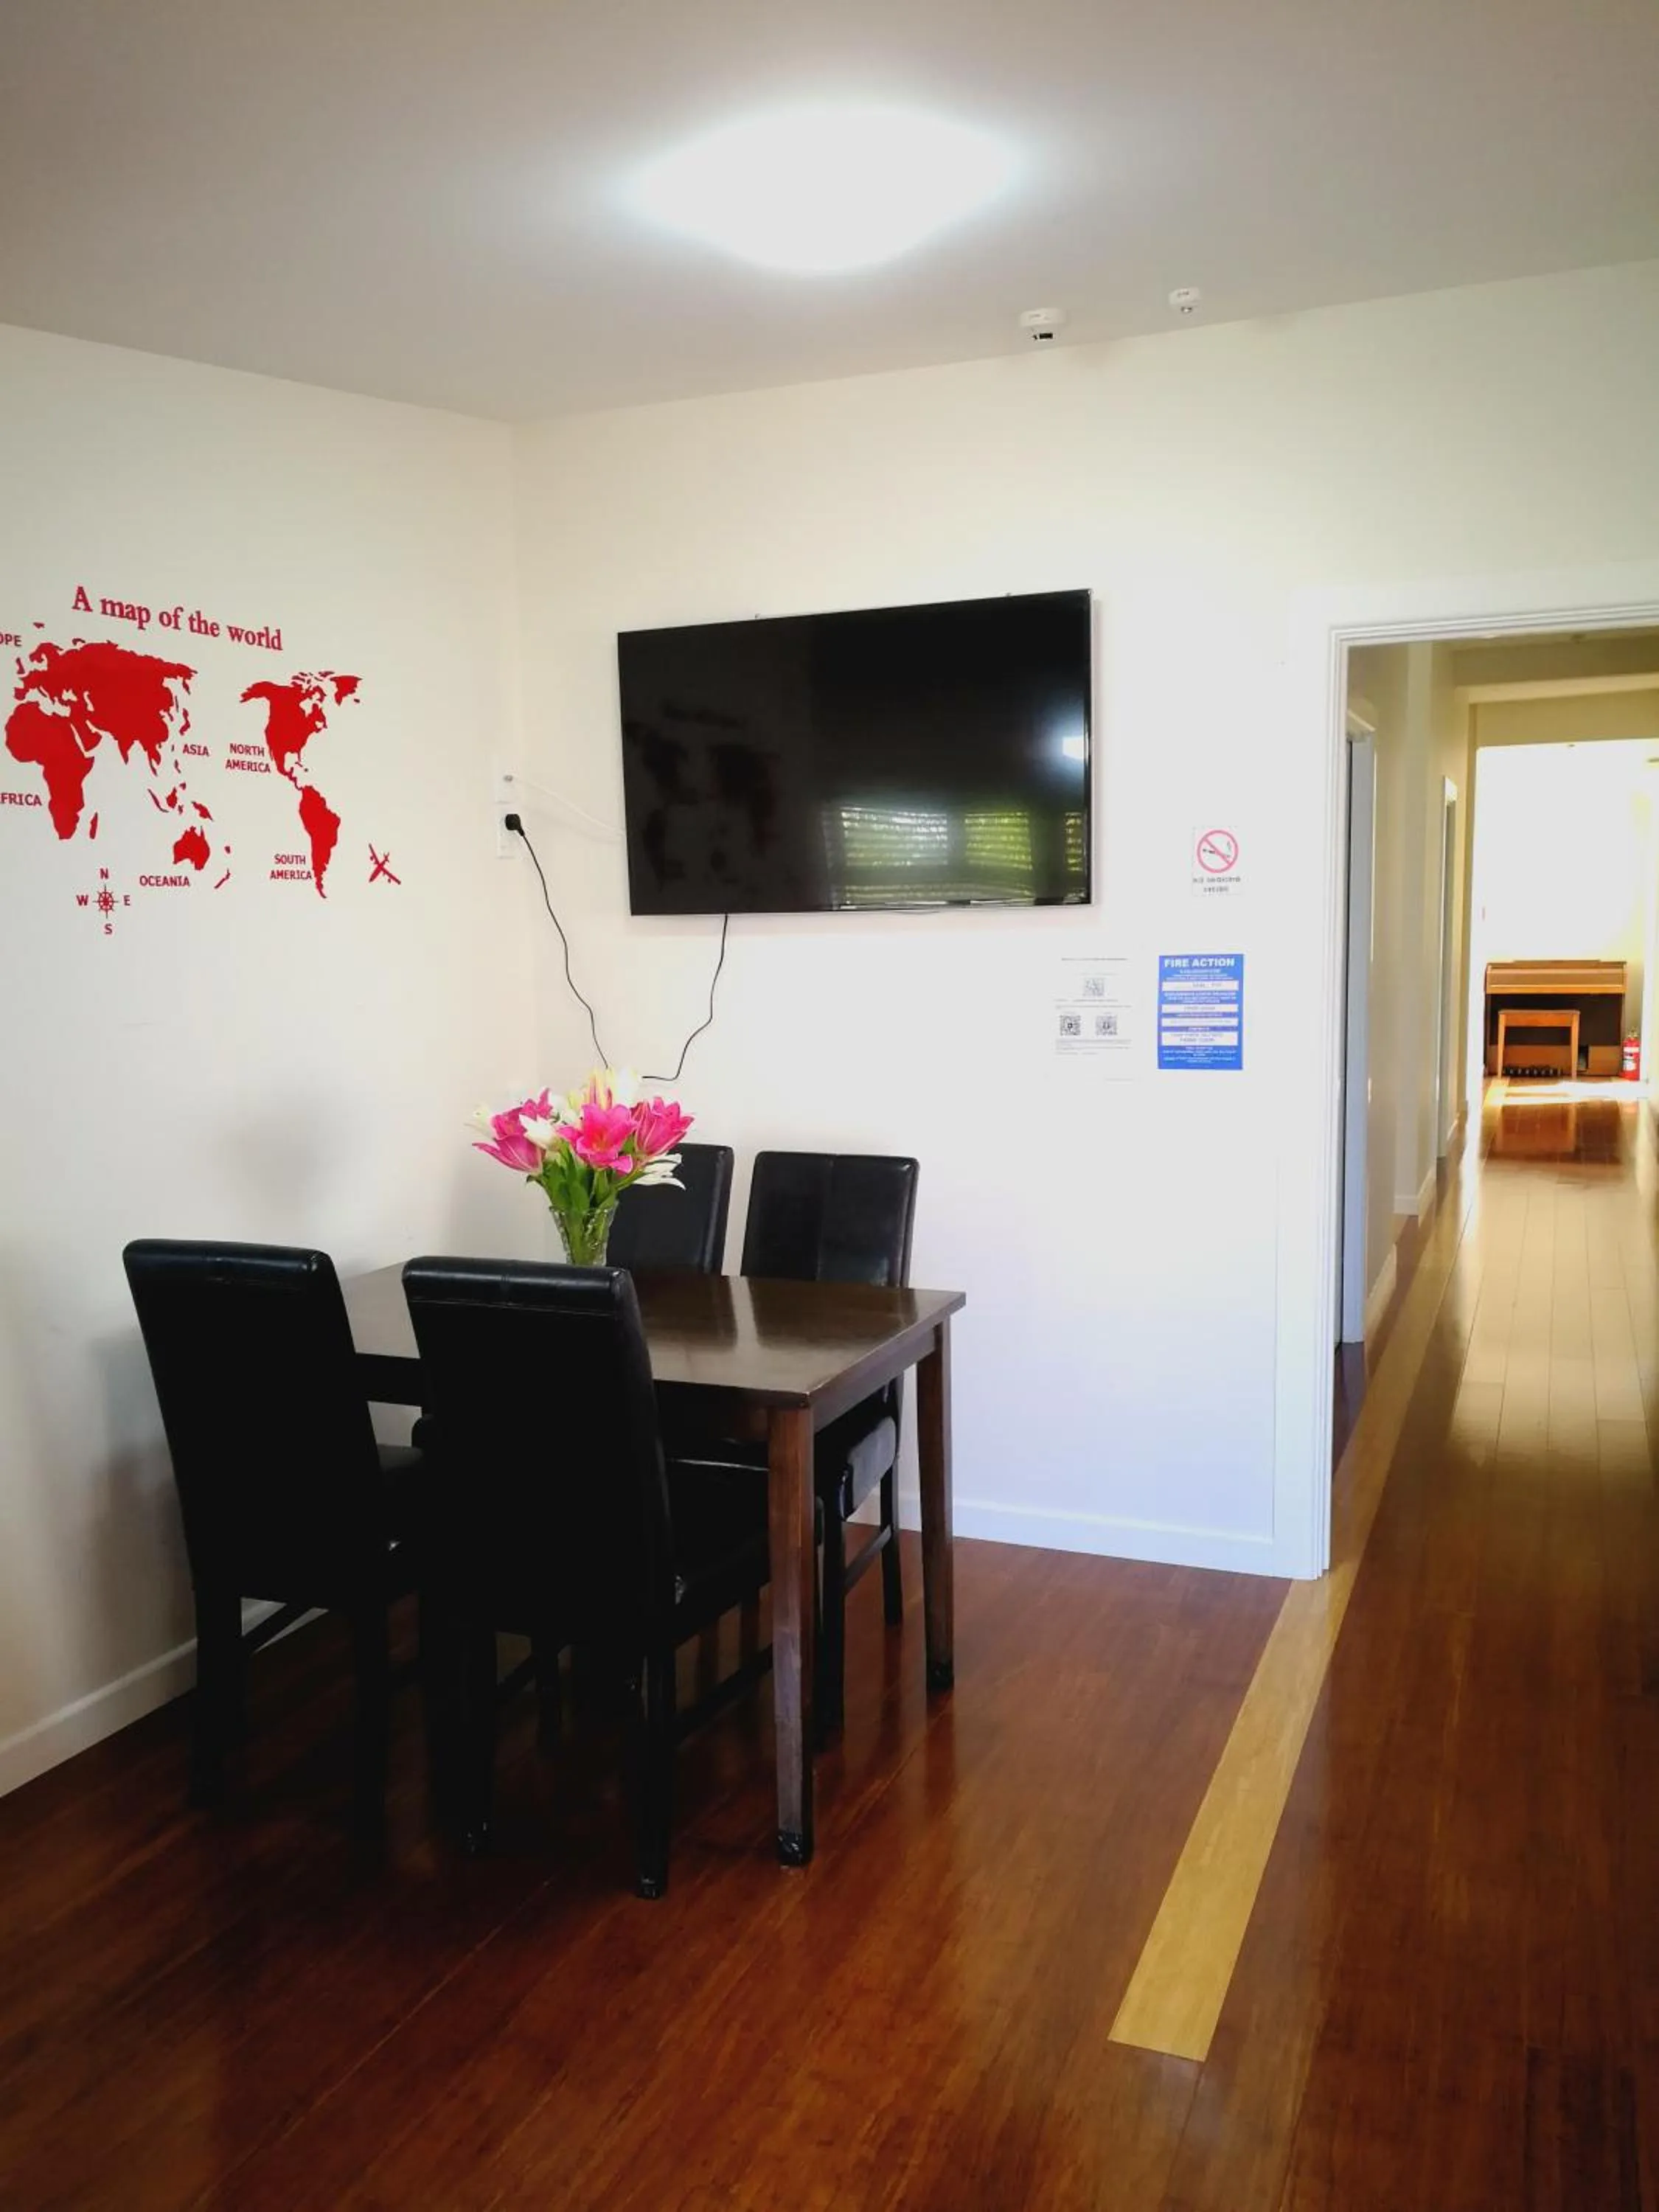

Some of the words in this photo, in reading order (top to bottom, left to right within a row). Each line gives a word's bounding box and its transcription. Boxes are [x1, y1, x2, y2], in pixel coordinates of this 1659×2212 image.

[72, 585, 93, 613] A
[100, 598, 151, 631] map
[158, 607, 183, 630] of
[188, 613, 220, 638] the
[227, 625, 282, 653] world
[182, 743, 209, 757] ASIA
[229, 742, 265, 757] NORTH
[225, 758, 271, 774] AMERICA
[274, 854, 307, 866] SOUTH
[99, 867, 109, 880] N
[269, 868, 313, 881] AMERICA
[139, 875, 191, 888] OCEANIA
[76, 895, 89, 907] W
[124, 895, 131, 906] E
[105, 923, 113, 935] S
[1164, 958, 1189, 968] FIRE
[1192, 957, 1236, 967] ACTION
